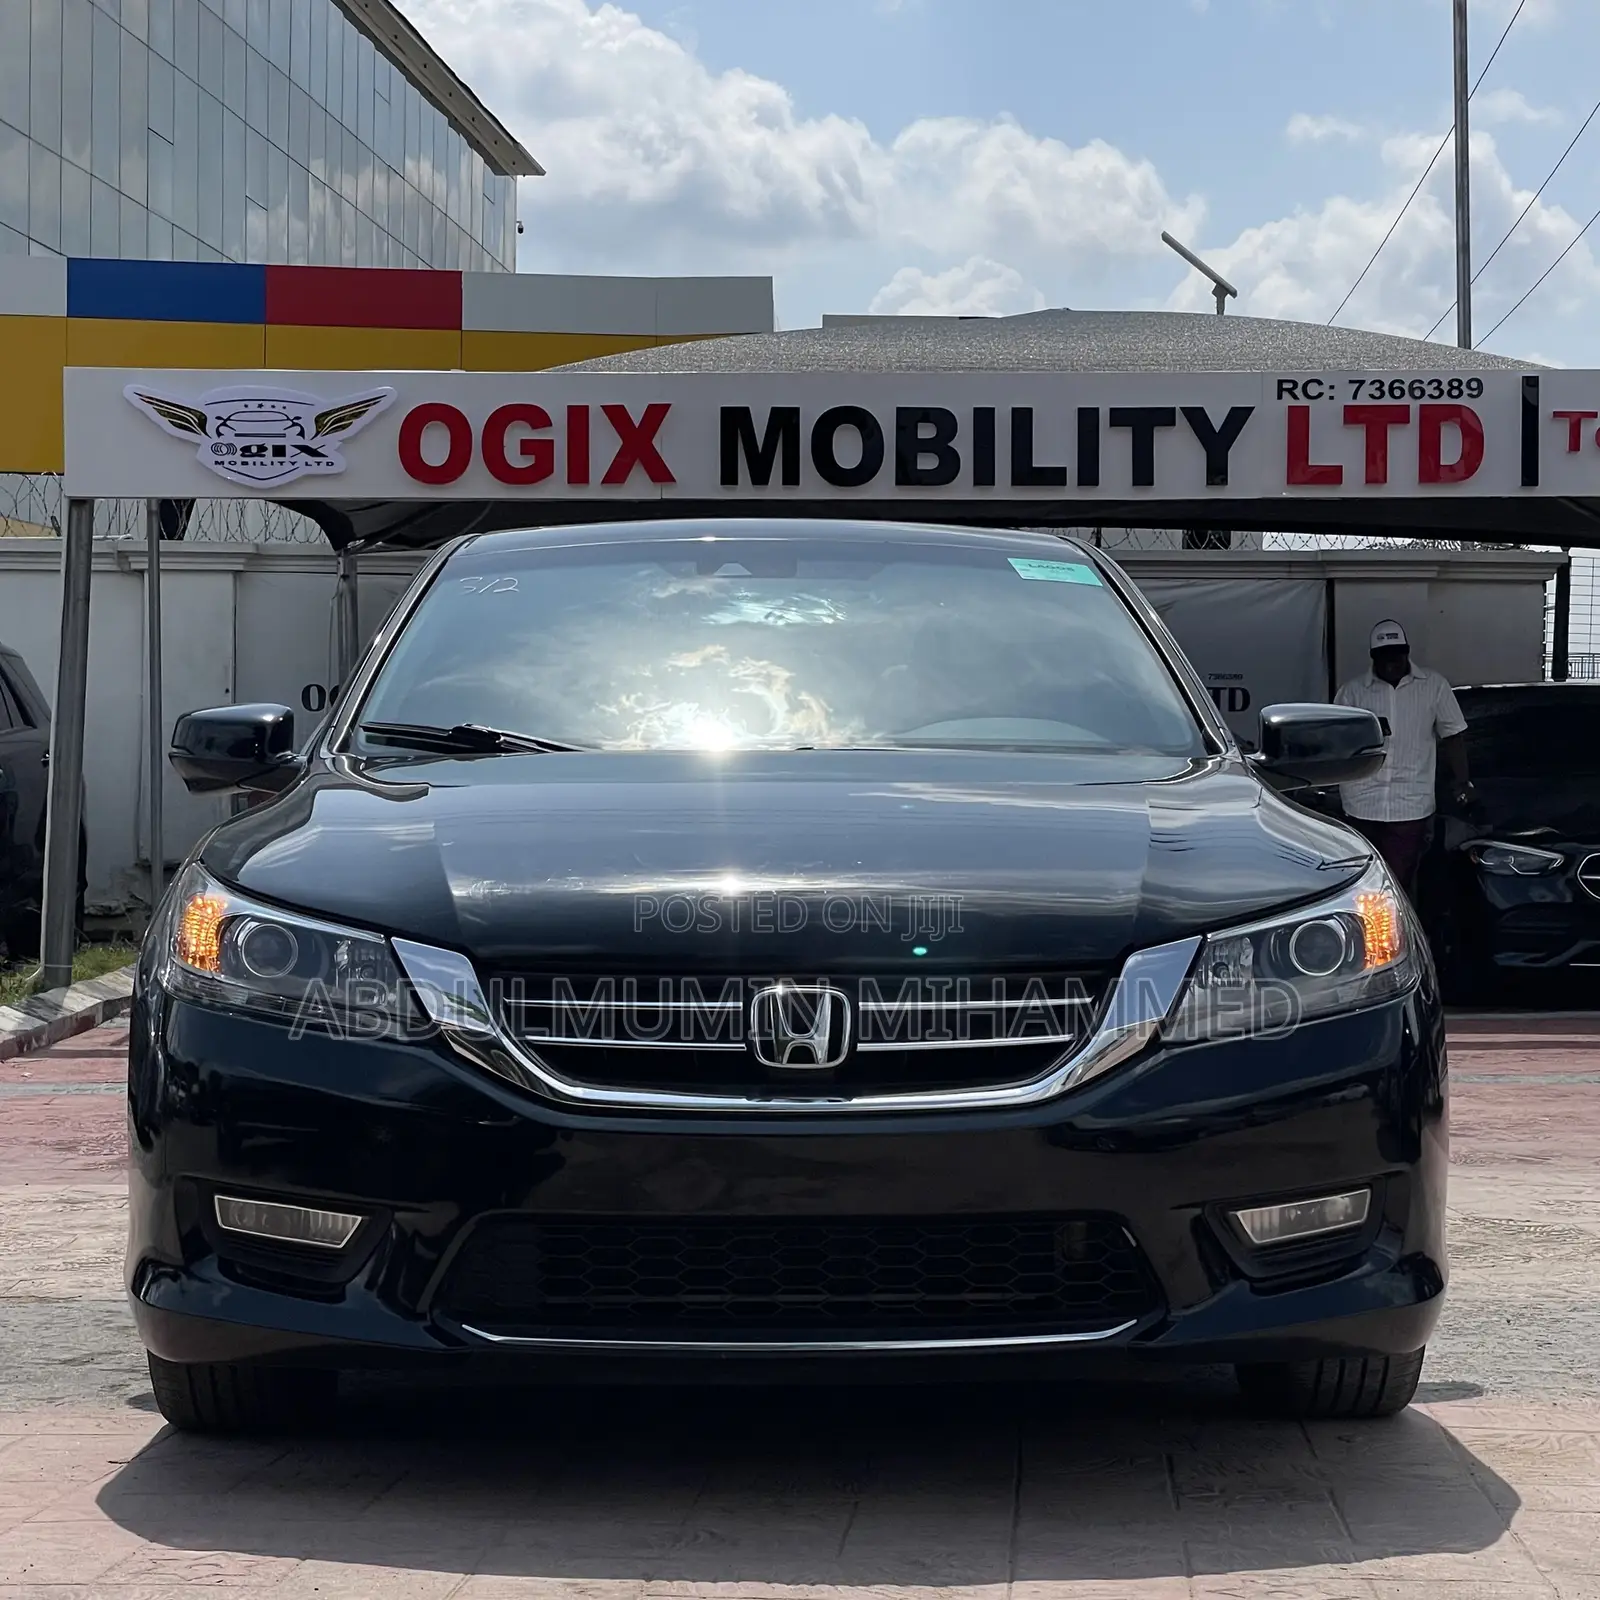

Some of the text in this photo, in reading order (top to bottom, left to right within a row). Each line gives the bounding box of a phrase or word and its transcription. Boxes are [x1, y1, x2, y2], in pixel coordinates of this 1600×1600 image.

[1276, 377, 1484, 400] RC: 7366389
[398, 402, 677, 486] OGIX
[719, 406, 1255, 486] MOBILITY
[1286, 404, 1485, 485] LTD
